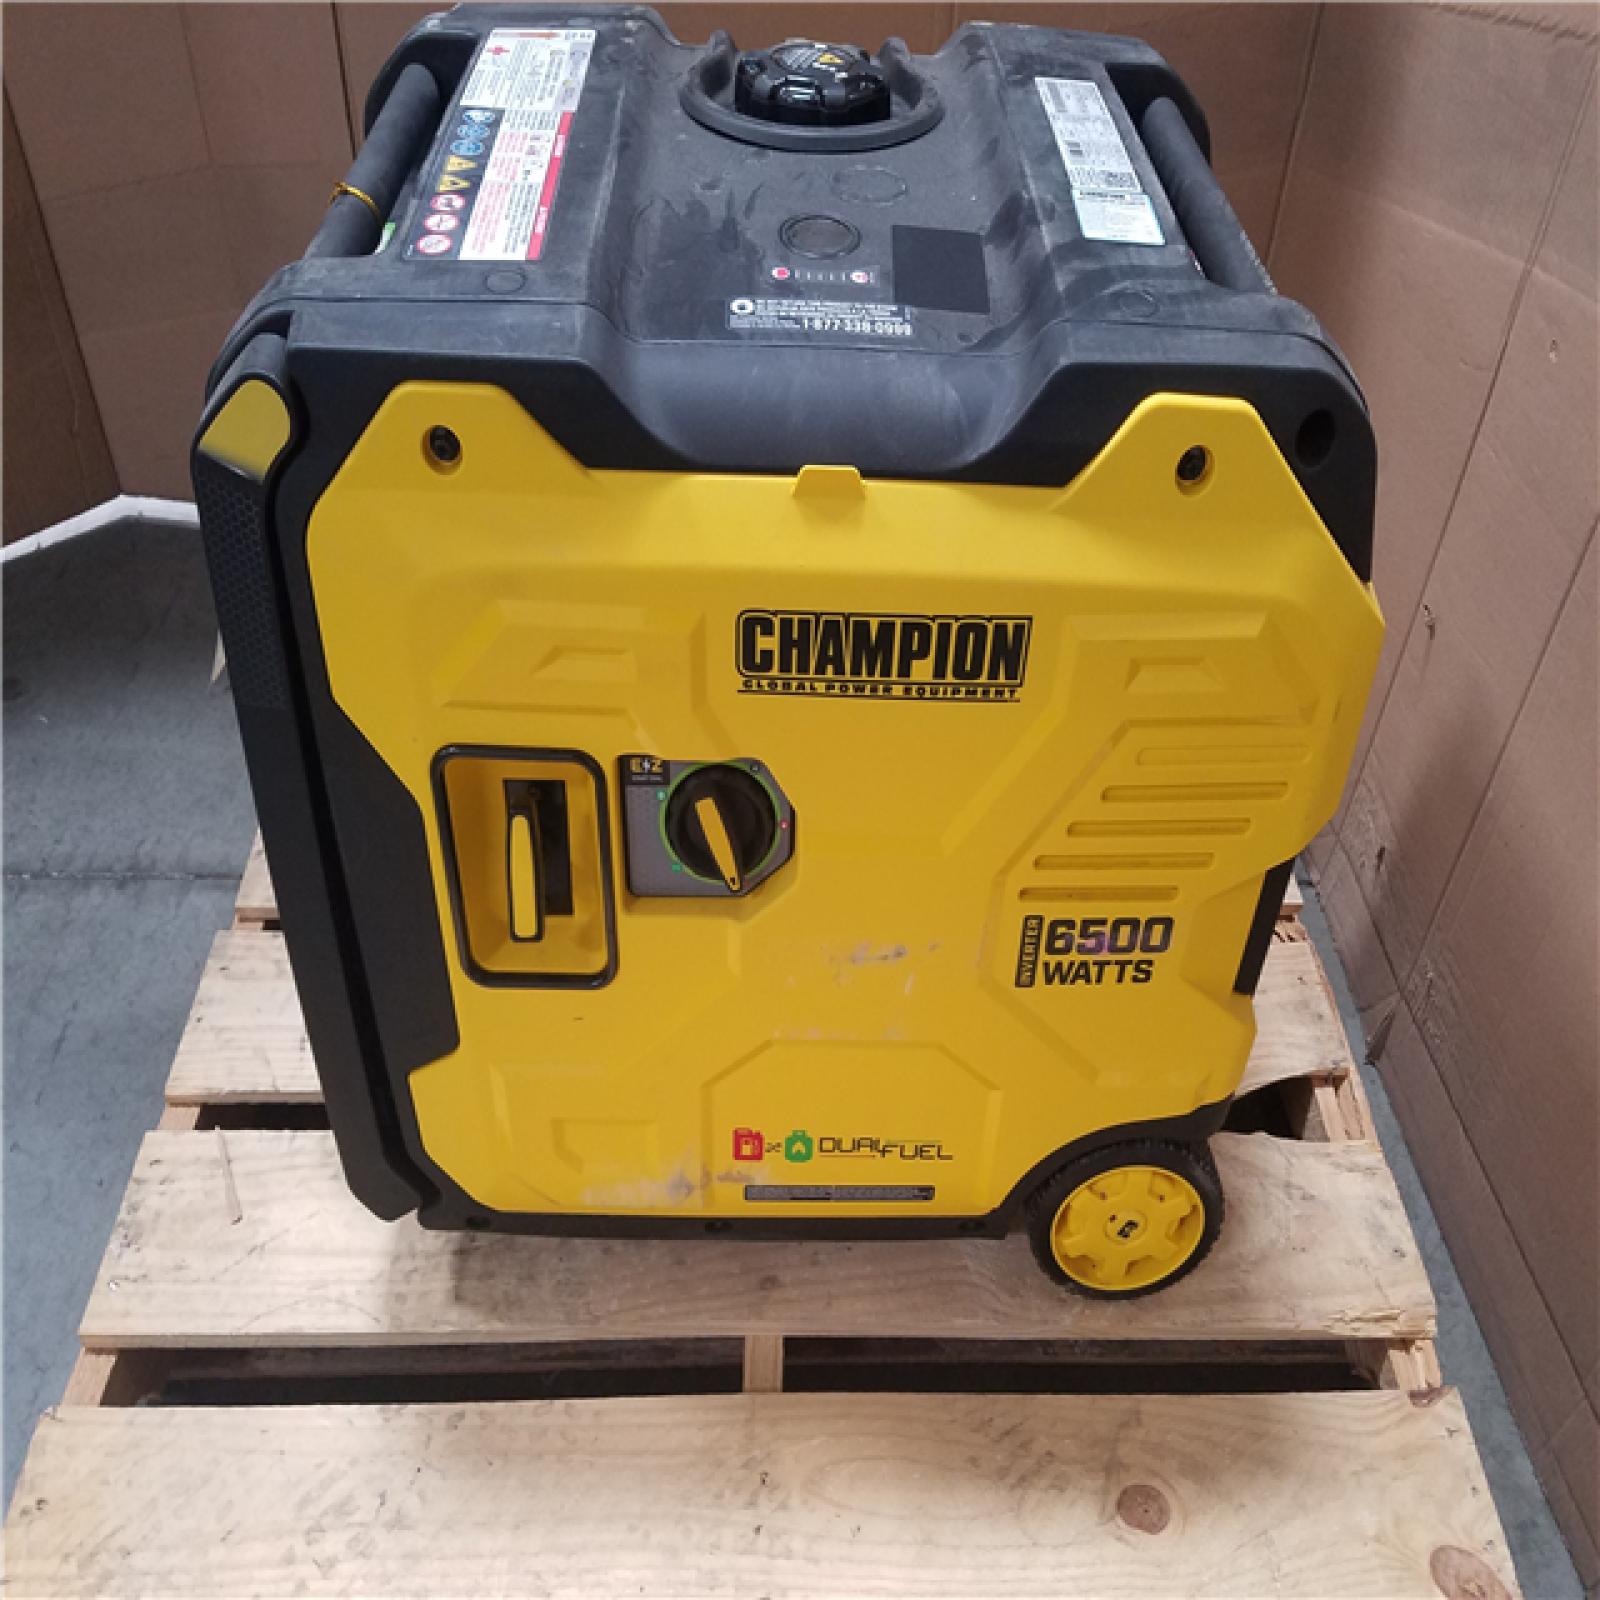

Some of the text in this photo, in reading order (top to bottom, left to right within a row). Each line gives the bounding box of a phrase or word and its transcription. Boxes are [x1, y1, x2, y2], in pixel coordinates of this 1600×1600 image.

[741, 615, 1026, 681] CHAMPION
[742, 679, 1017, 699] GLOBAL POWER EQUIPMENT
[1019, 919, 1040, 986] INVERTER
[1044, 916, 1174, 956] 6500
[1043, 960, 1154, 986] WATTS
[880, 1142, 954, 1161] FUEL
